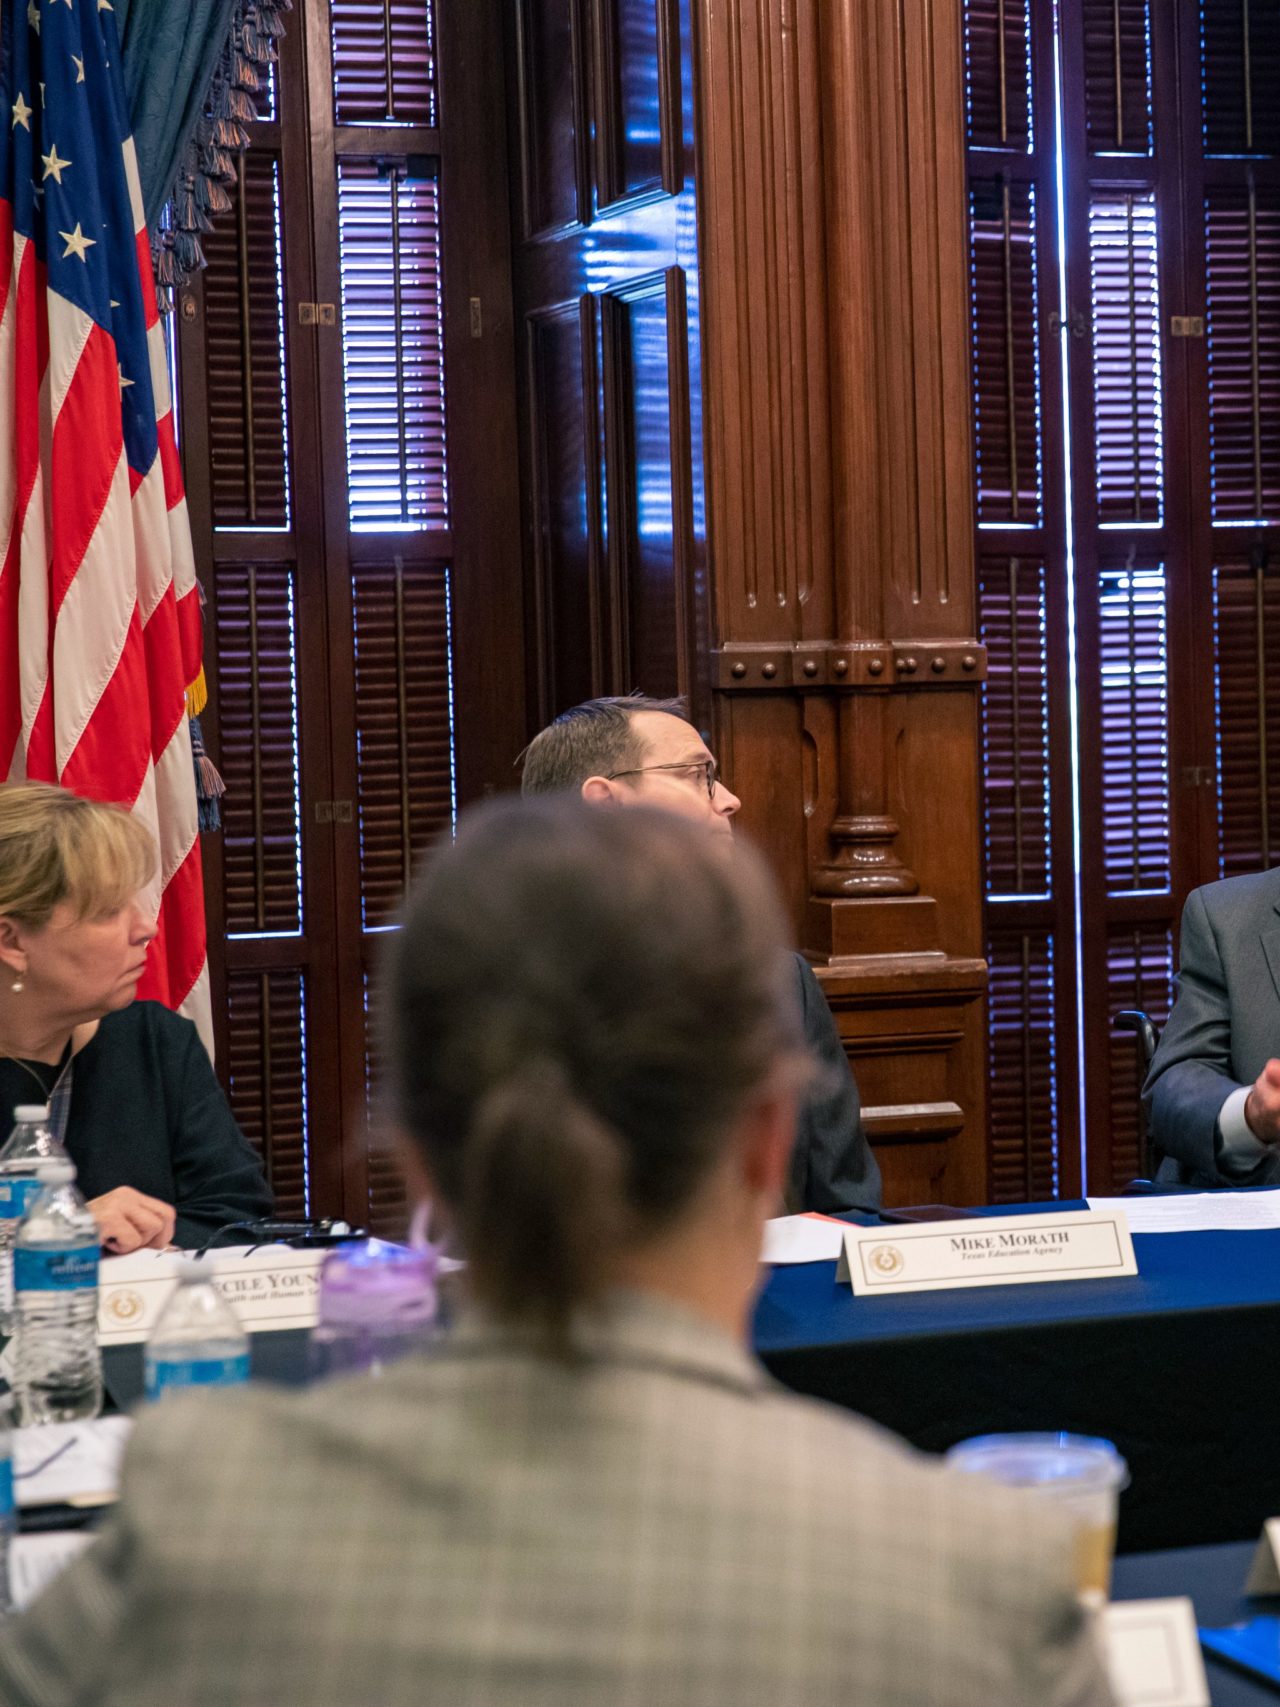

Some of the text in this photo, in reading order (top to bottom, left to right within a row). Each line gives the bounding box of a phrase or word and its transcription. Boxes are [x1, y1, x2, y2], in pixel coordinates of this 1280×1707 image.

[950, 1231, 1070, 1252] MIKE MORATH
[961, 1246, 1063, 1261] Texas Education Agency
[266, 1273, 321, 1289] YOUN
